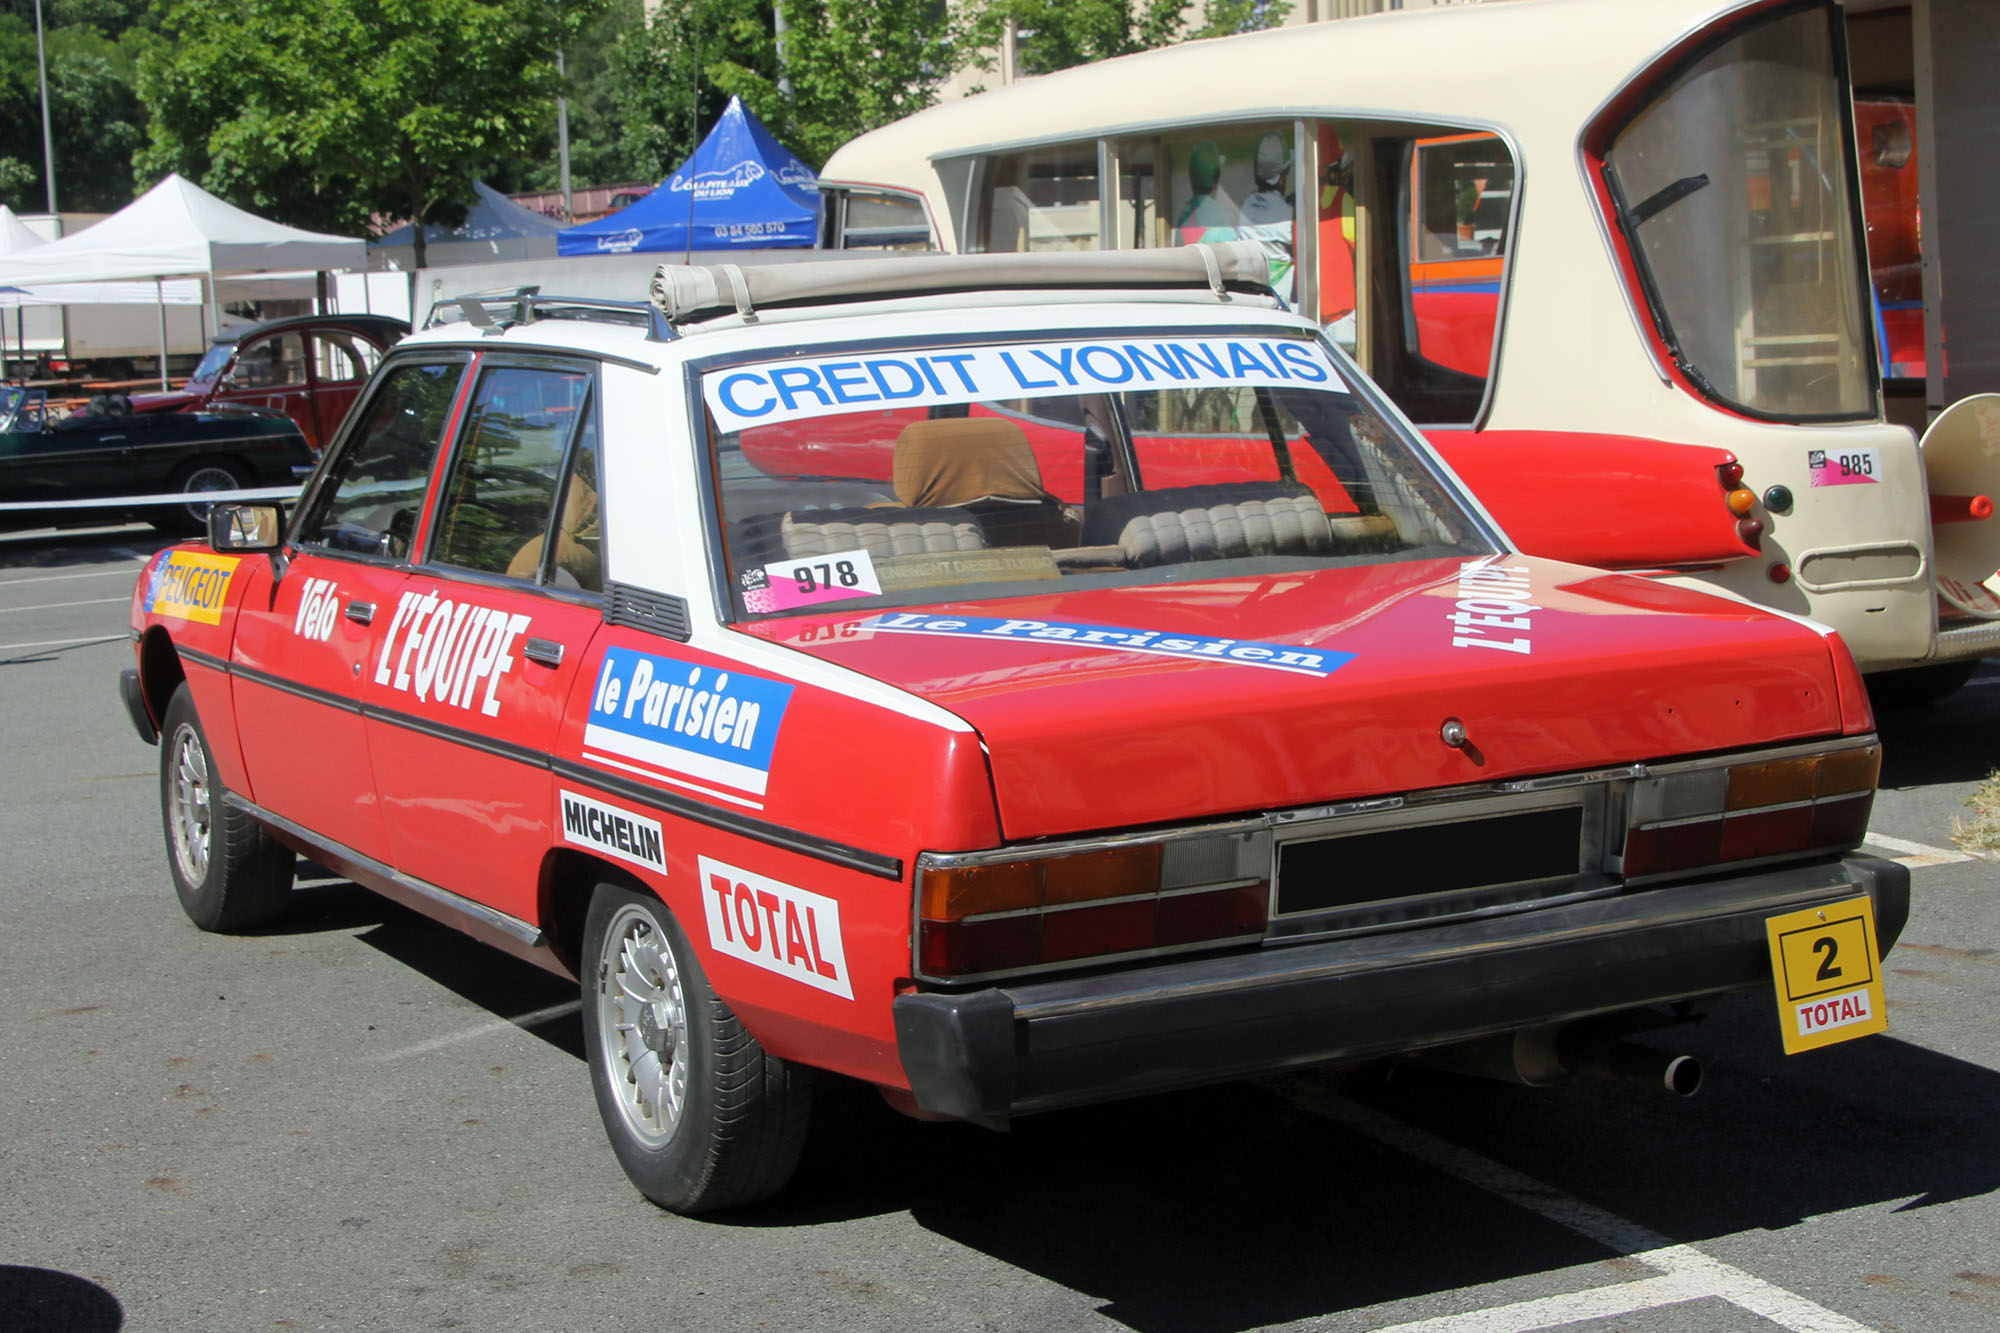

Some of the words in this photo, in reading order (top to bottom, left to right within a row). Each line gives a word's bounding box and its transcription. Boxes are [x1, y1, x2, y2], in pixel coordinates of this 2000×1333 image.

[715, 225, 729, 238] 03
[718, 354, 978, 418] CREDIT
[1000, 341, 1328, 390] LYONNAIS
[1840, 454, 1873, 476] 985
[161, 564, 232, 609] PEUGEOT
[792, 559, 860, 594] 978
[374, 589, 532, 718] L'ÉQUIPE
[873, 612, 968, 631] Le
[981, 618, 1324, 668] Parisien
[594, 658, 622, 715] le
[622, 658, 761, 751] Parisien
[563, 799, 663, 866] MICHELIN
[709, 872, 838, 982] TOTAL
[1812, 936, 1843, 982] 2
[1800, 995, 1866, 1029] TOTAL
